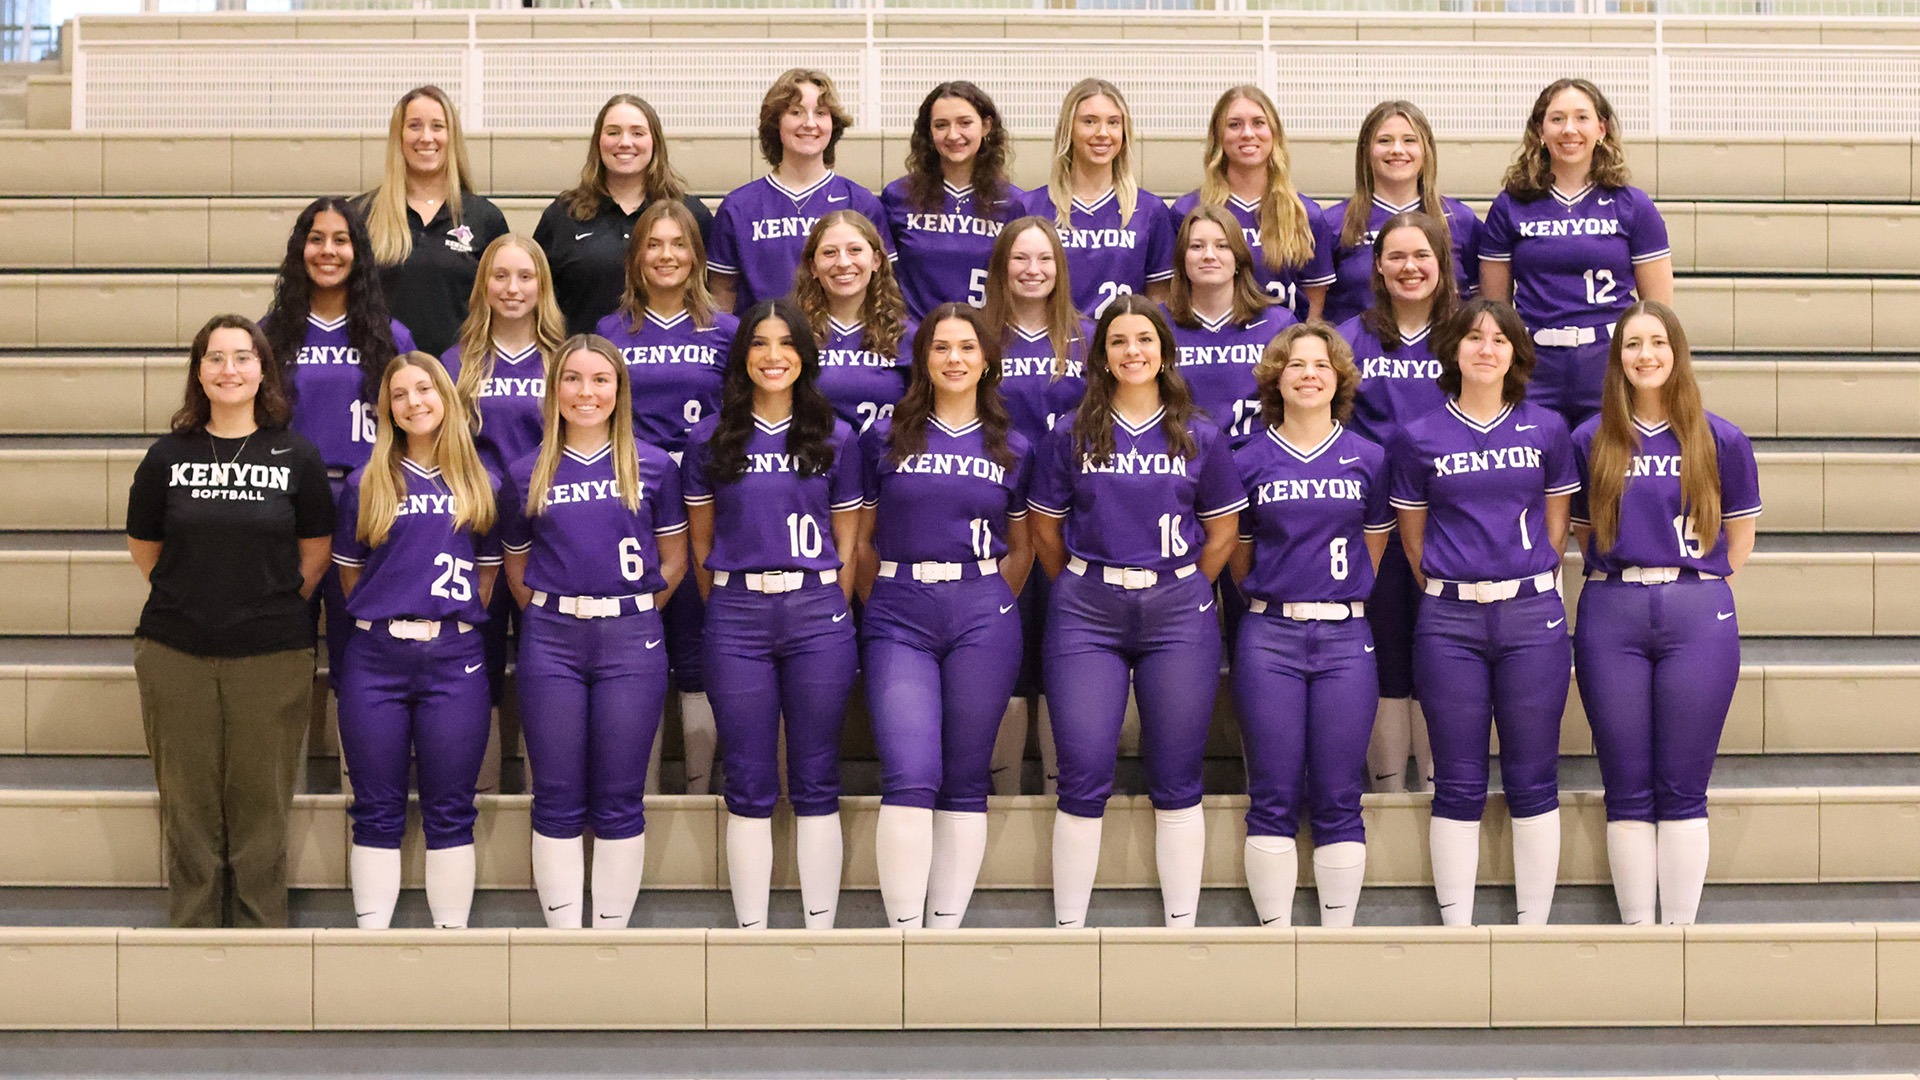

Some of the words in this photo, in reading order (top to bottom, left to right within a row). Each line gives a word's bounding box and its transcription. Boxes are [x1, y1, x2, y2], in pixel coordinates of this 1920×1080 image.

[752, 216, 821, 241] KENY
[906, 212, 1004, 237] KENYON
[1519, 217, 1618, 237] KENYON
[1056, 228, 1136, 249] ENYON
[968, 268, 988, 308] 5
[1583, 269, 1617, 304] 12
[297, 346, 361, 364] ENYO
[621, 344, 717, 365] KENYON
[818, 349, 896, 367] ENYON
[1001, 357, 1083, 378] ENYON
[1175, 344, 1265, 367] ENYON
[1362, 355, 1443, 379] KENYO
[479, 378, 545, 398] ENYO
[350, 399, 377, 444] 16
[1230, 399, 1262, 437] 17
[896, 453, 1006, 485] KENYON
[1081, 453, 1187, 477] KENYON
[1434, 446, 1542, 476] KENYON
[169, 462, 290, 490] KENYON
[190, 488, 265, 501] SOFTBALL
[1257, 479, 1362, 505] KENYON
[786, 513, 822, 559] 10
[970, 518, 991, 560] 11
[1519, 507, 1532, 550] 1
[1673, 515, 1704, 559] 15
[618, 537, 644, 581] 6
[1329, 537, 1348, 580] 8
[430, 552, 474, 602] 25
